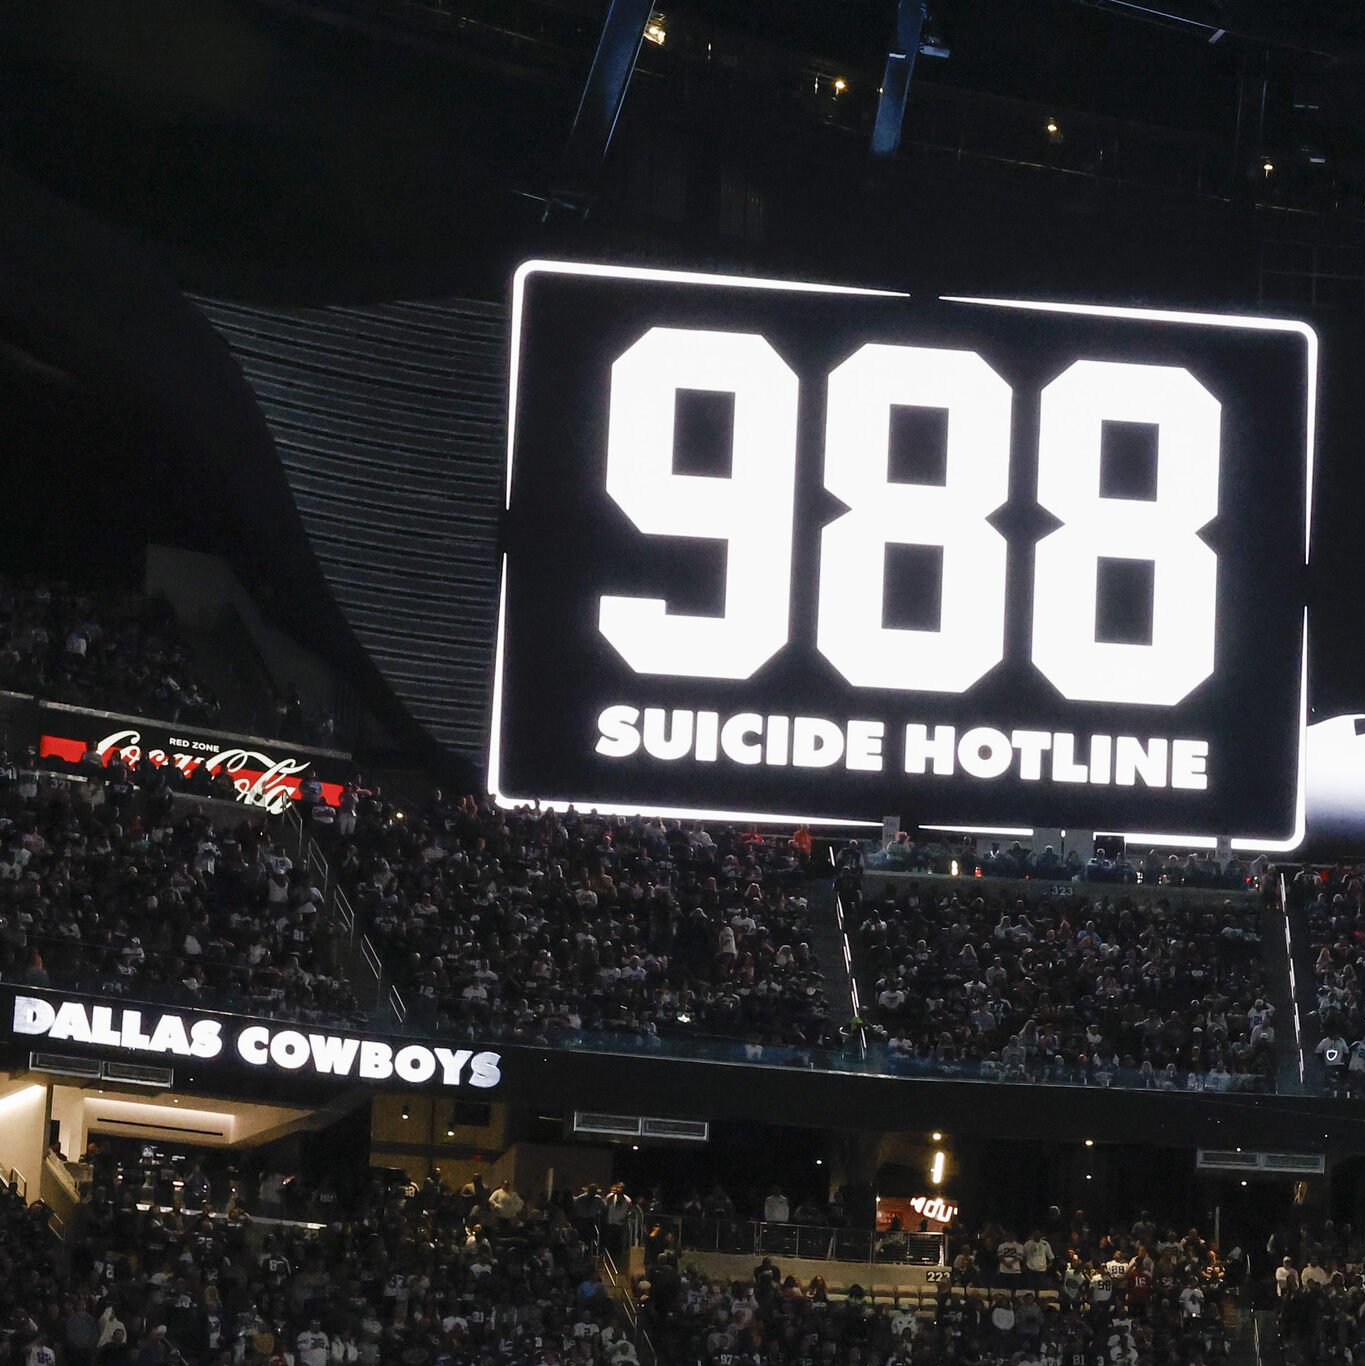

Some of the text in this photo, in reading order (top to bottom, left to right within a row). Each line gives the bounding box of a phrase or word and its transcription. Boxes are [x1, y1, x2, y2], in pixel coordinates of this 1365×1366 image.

[599, 326, 1222, 707] 988
[169, 737, 220, 753] RED ZONE
[594, 704, 1209, 790] SUICIDE HOTLINE
[1051, 886, 1073, 896] 323
[13, 996, 502, 1088] DALLAS COWBOYS
[1003, 1248, 1016, 1257] 22
